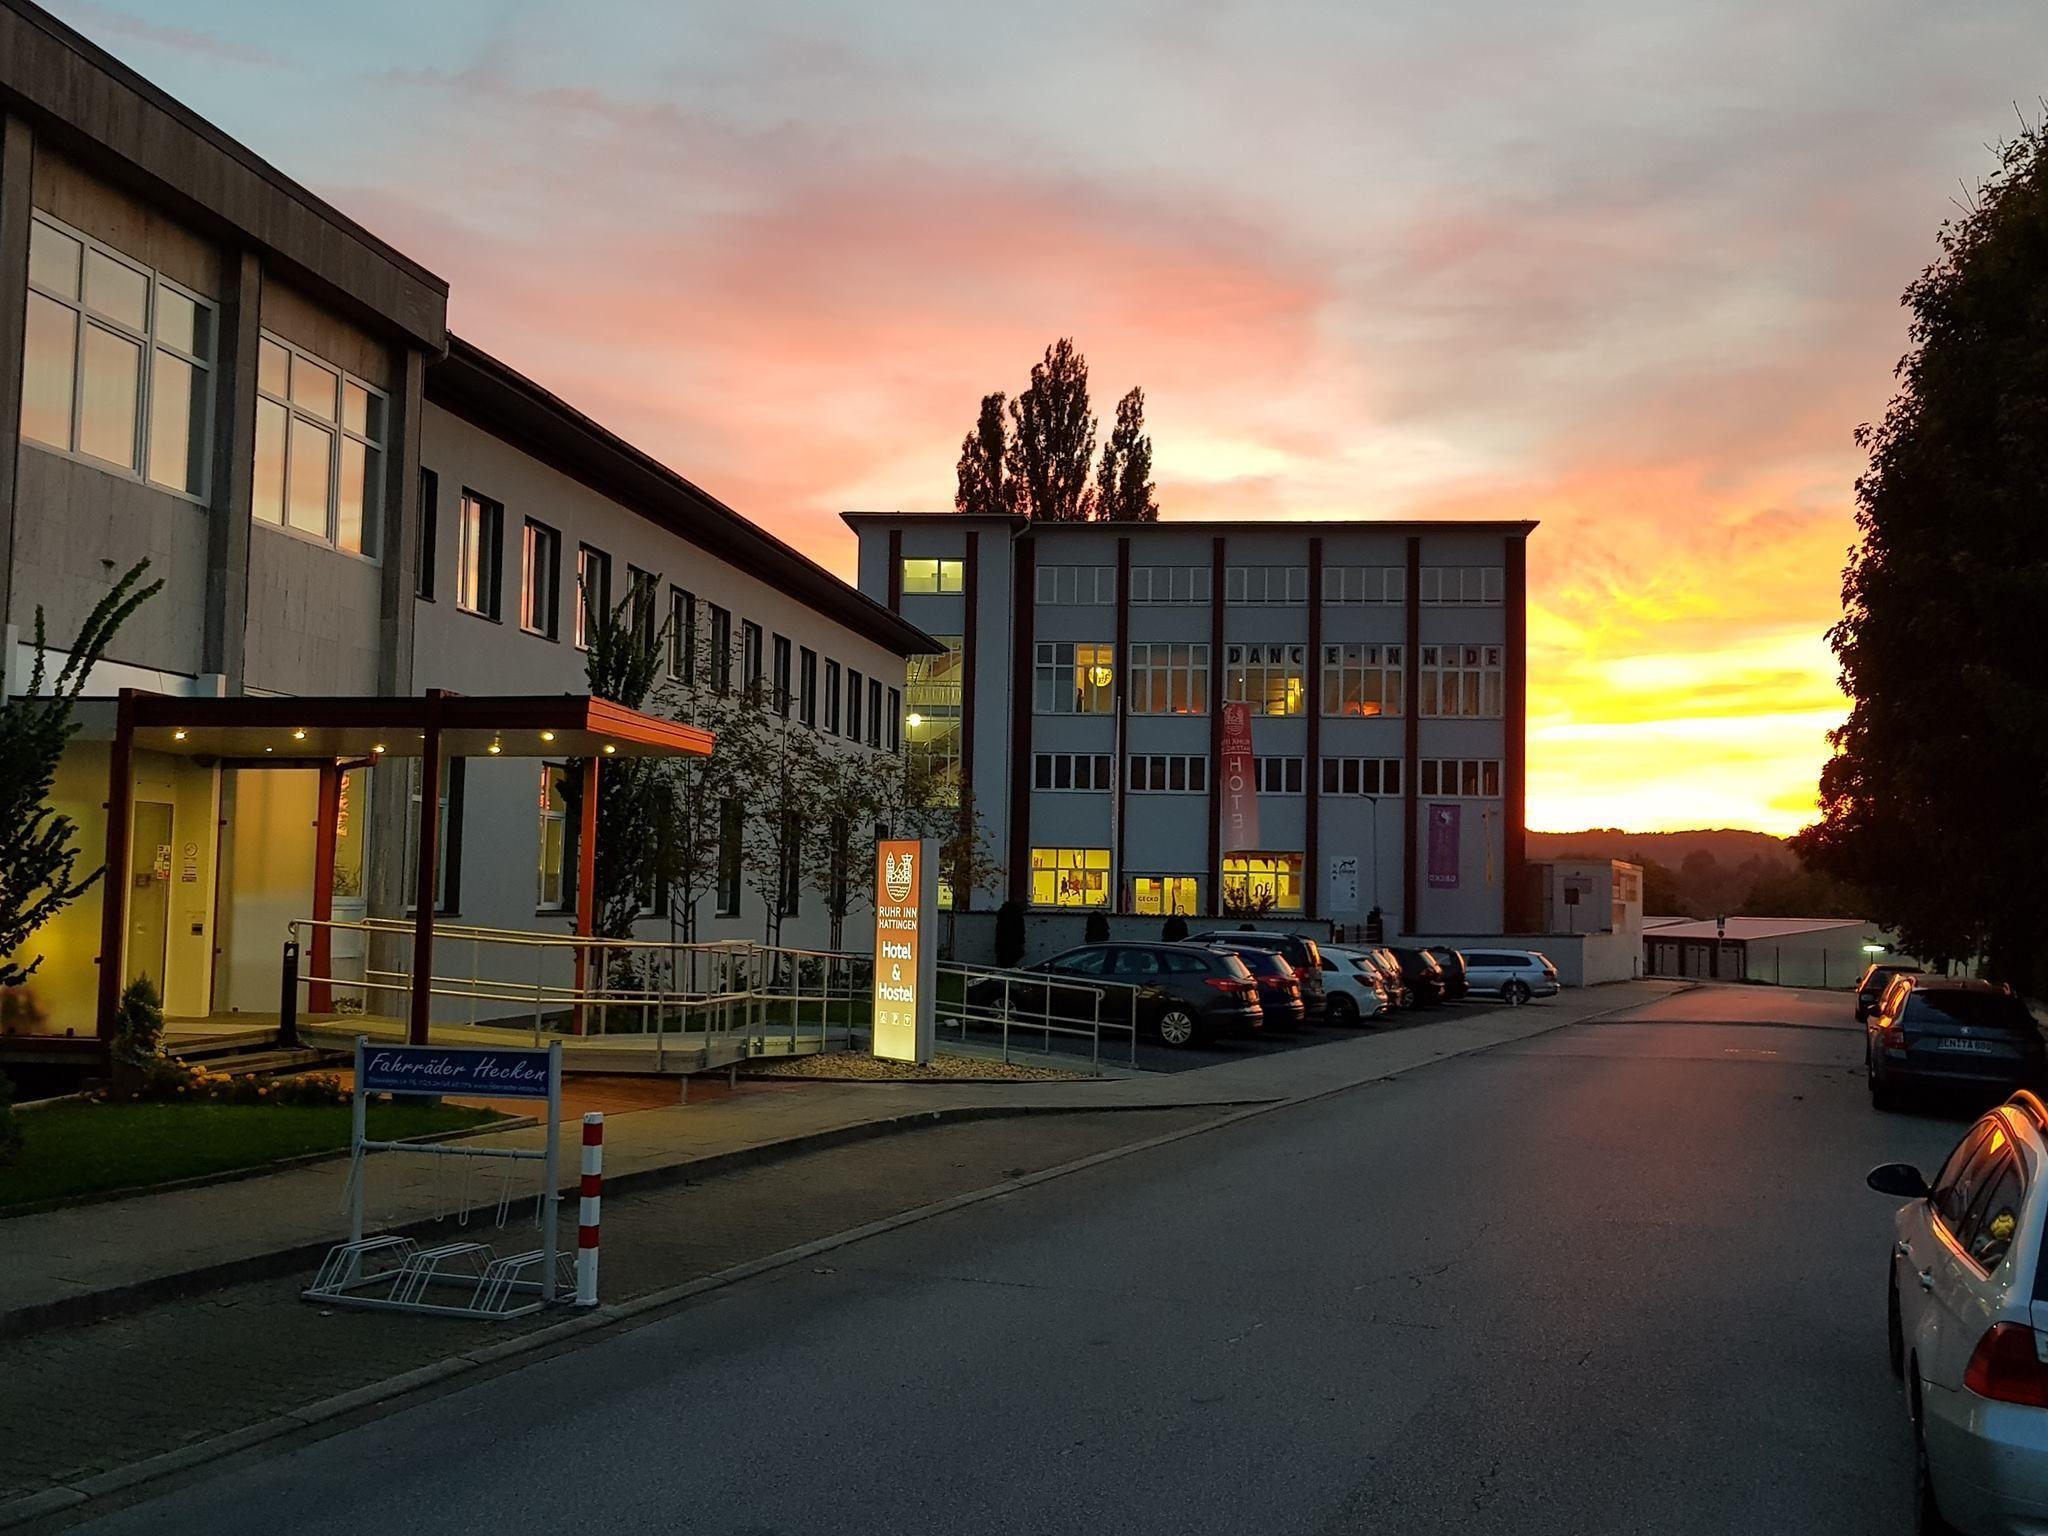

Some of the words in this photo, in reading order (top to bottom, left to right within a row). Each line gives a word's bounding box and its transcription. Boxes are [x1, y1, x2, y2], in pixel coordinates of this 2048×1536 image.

[879, 906, 901, 917] RUHR
[903, 906, 917, 918] INN
[879, 919, 917, 930] HATTINGEN
[882, 941, 912, 960] Hotel
[891, 964, 901, 981] &
[878, 982, 914, 1002] Hostel
[368, 1052, 466, 1076] Fahrräder
[472, 1056, 547, 1081] Hecken
